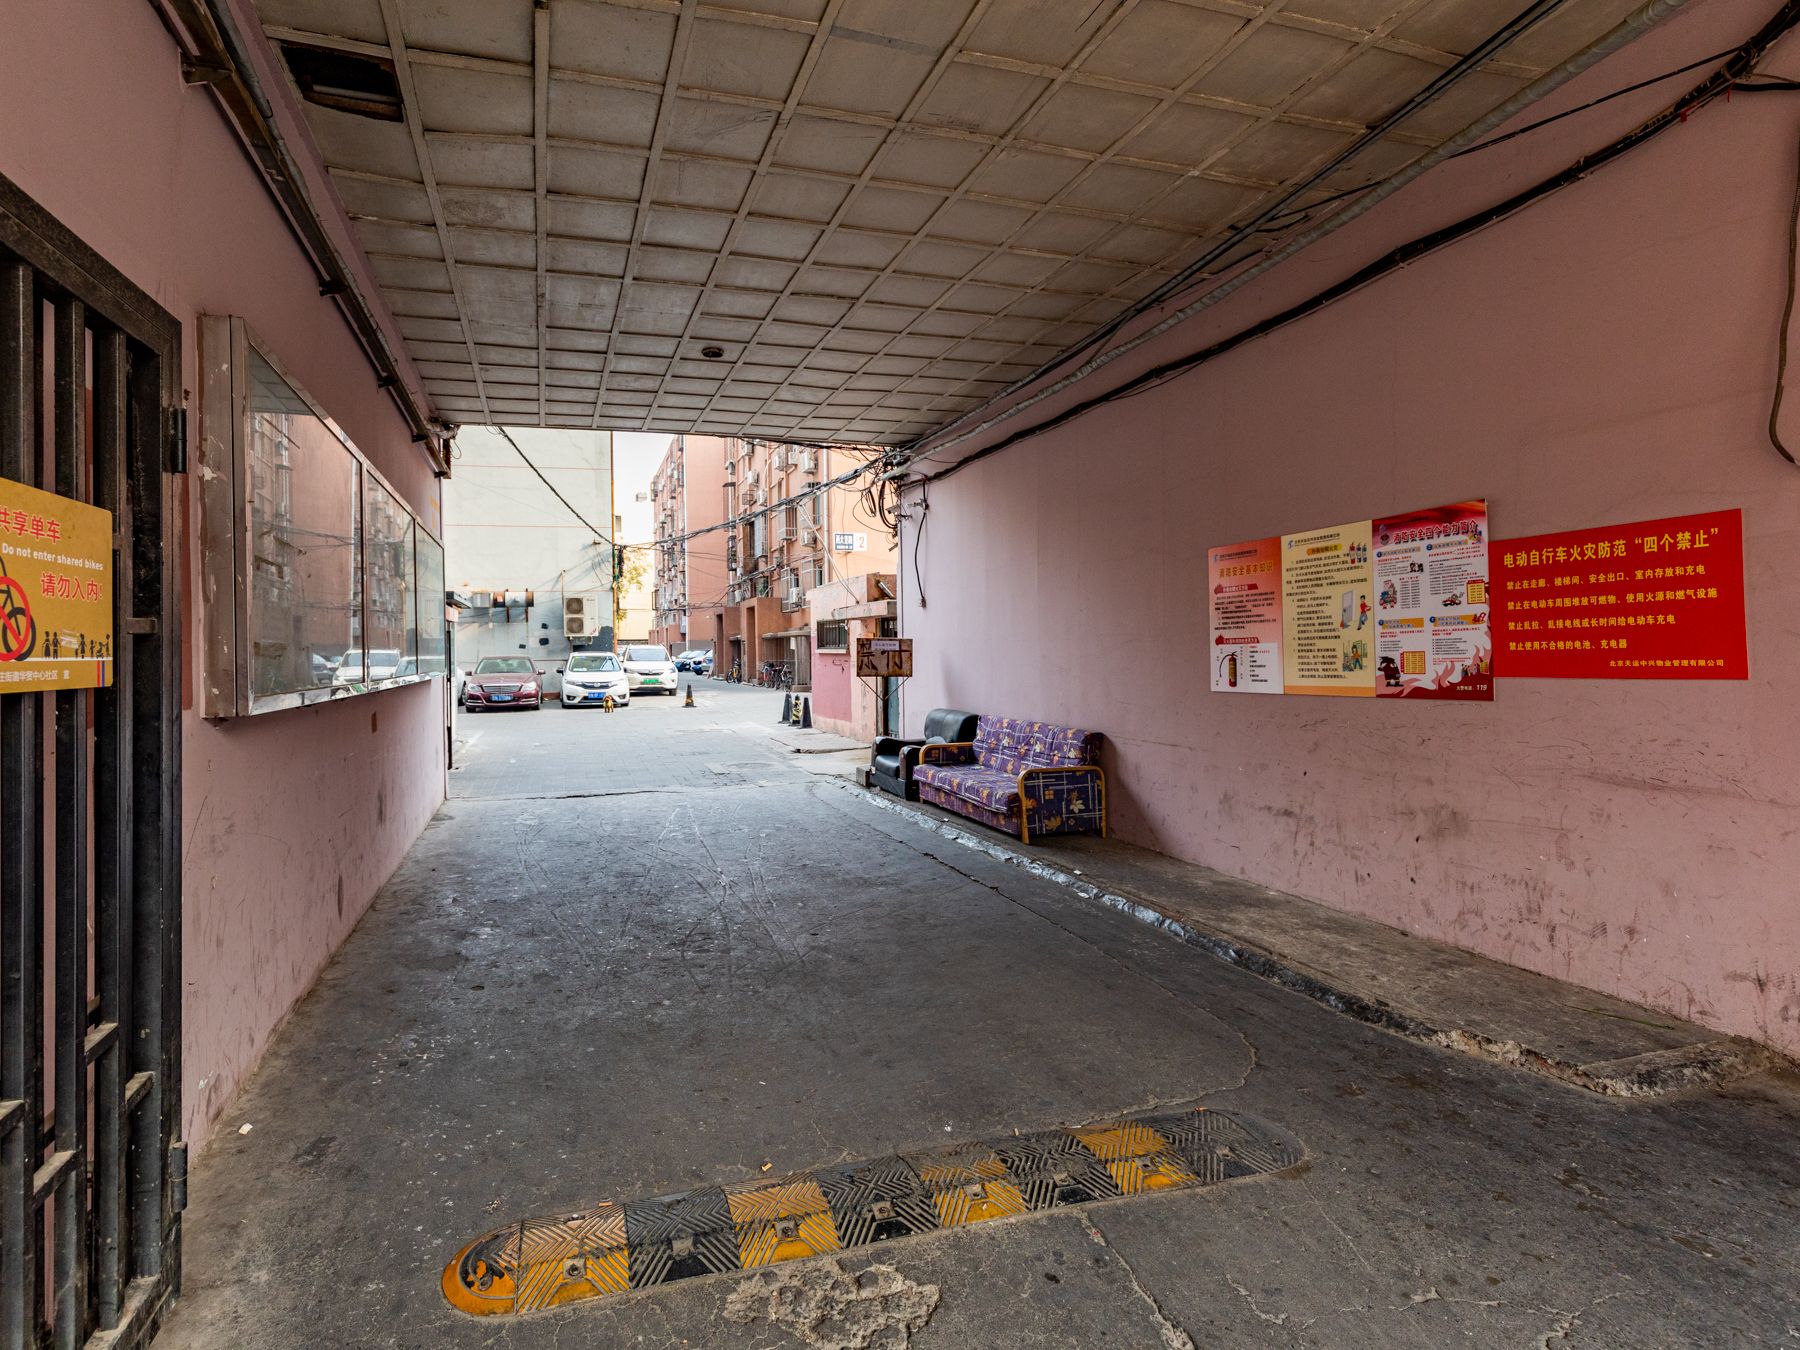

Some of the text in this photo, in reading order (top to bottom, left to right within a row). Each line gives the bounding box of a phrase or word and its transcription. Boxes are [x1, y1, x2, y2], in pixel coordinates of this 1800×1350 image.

[2, 543, 104, 571] Do not enter shared bikes
[1509, 638, 1628, 652] 禁止使用不合格的电池、充电器
